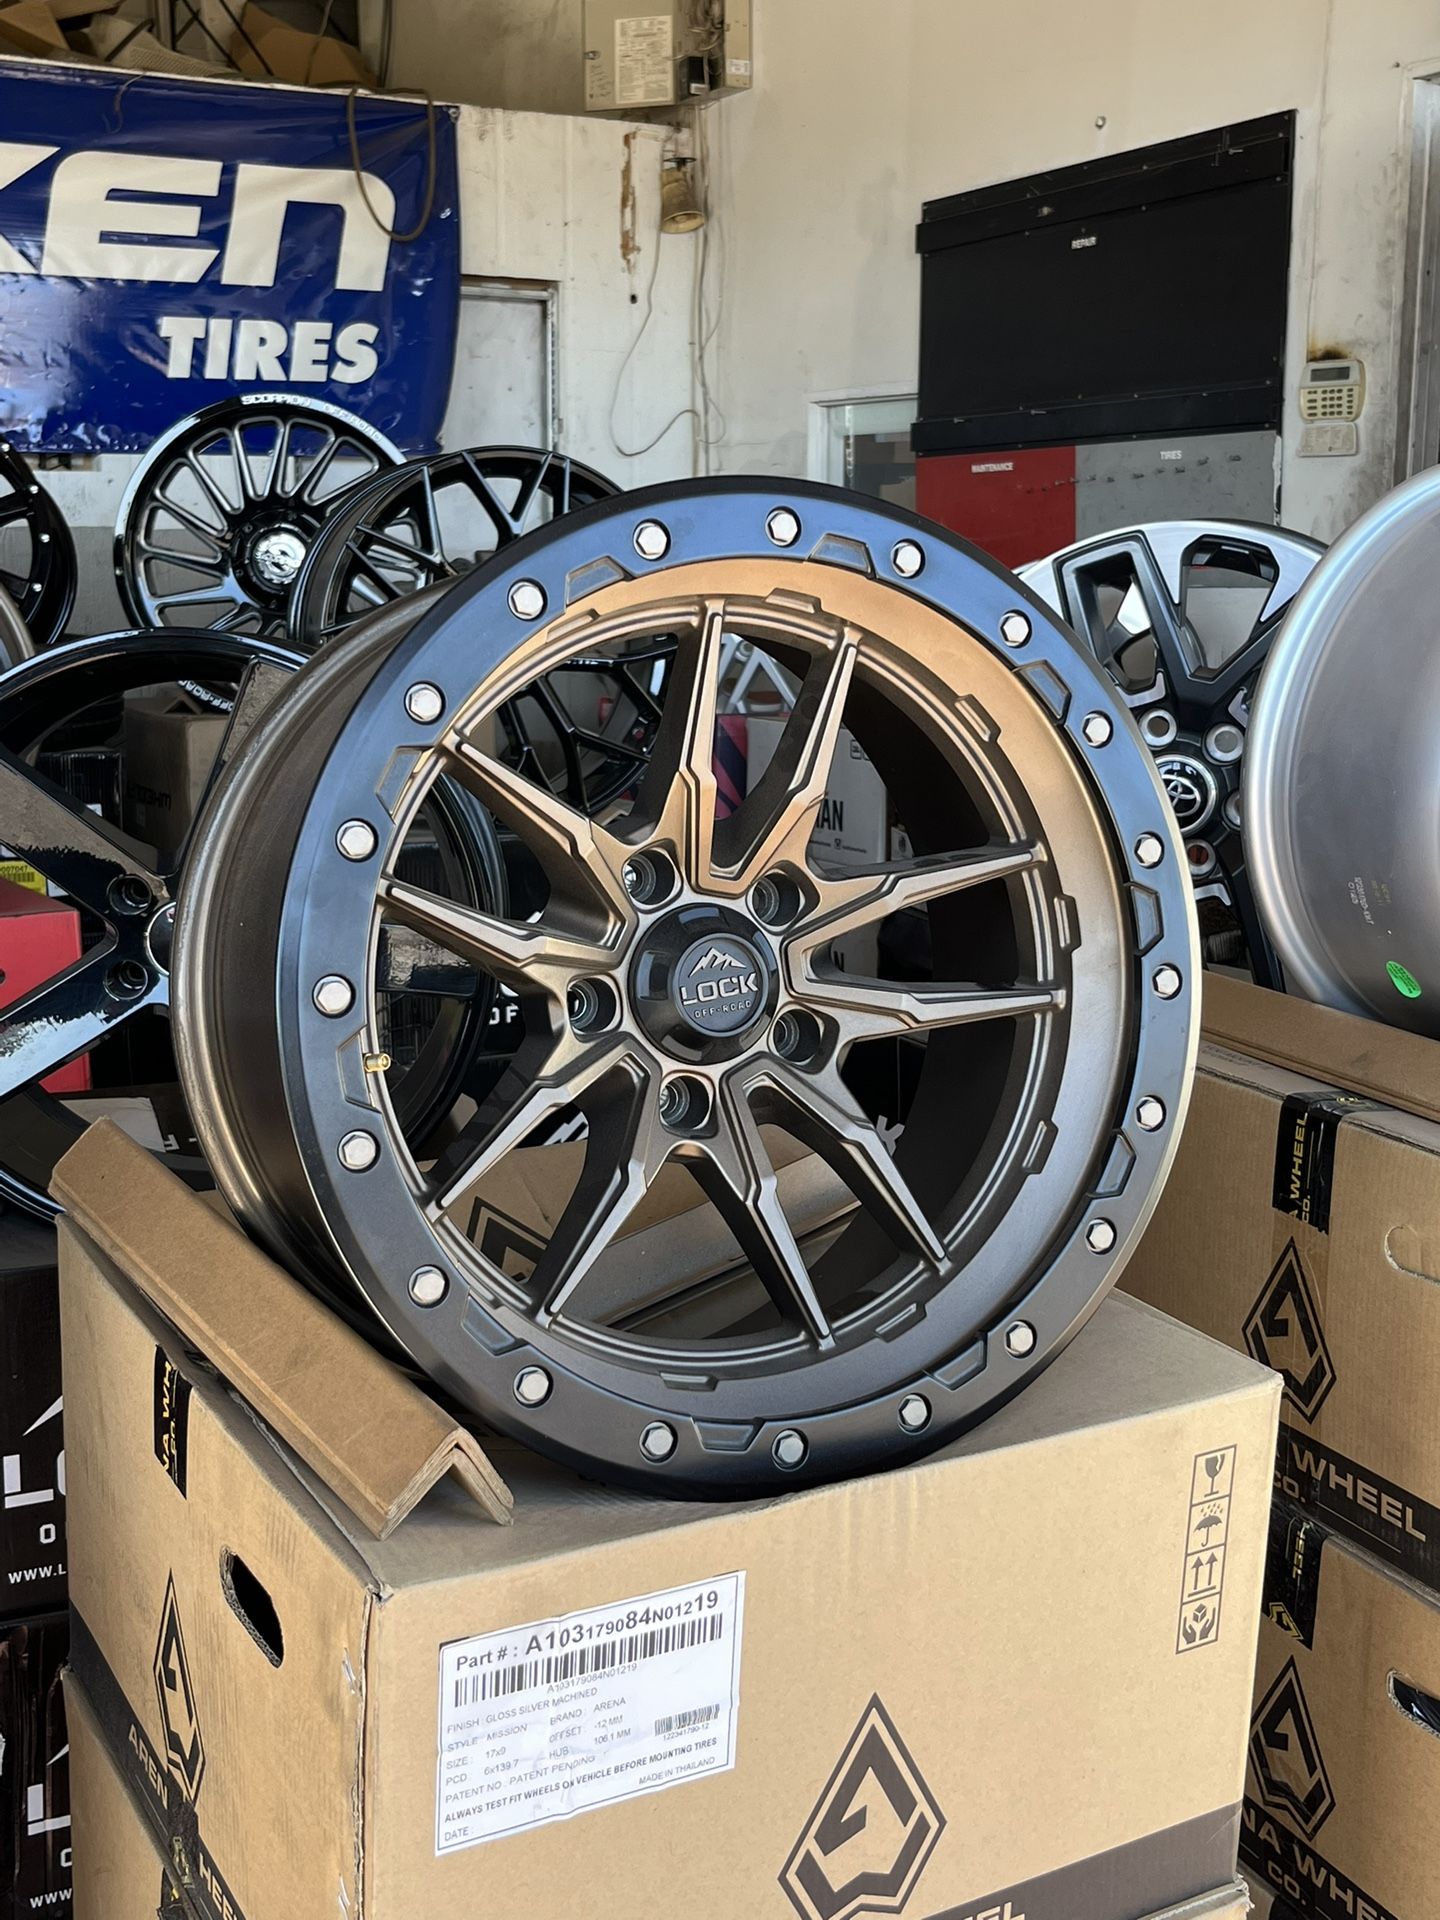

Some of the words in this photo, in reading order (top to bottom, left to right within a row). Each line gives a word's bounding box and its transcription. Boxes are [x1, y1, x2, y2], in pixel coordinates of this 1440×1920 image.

[160, 316, 381, 384] TIRES
[241, 393, 312, 408] SCORPION
[971, 462, 1014, 473] MAINTENANCE
[1160, 450, 1183, 460] TIRES
[679, 972, 759, 1006] LOCK
[694, 1000, 752, 1019] OFF-ROAD
[1289, 1111, 1309, 1199] WHEEL
[1291, 1441, 1427, 1543] WHEEL
[456, 1650, 493, 1671] Part
[525, 1590, 719, 1655] A103179084N01219
[547, 1662, 638, 1694] A103179084N01219
[486, 1708, 518, 1724] GLOSS
[519, 1699, 550, 1715] SILVER
[552, 1687, 598, 1707] MACHINED
[550, 1708, 583, 1726] BRAND
[593, 1697, 626, 1713] ARENA
[447, 1736, 478, 1752] STYLE
[486, 1723, 528, 1741] MISSION
[549, 1725, 582, 1743] OFFSET
[549, 1746, 569, 1760] HUB
[594, 1732, 614, 1745] 1061
[617, 1728, 631, 1740] MM
[444, 1804, 483, 1824] ALWAYS
[485, 1797, 508, 1812] TEST
[509, 1792, 522, 1806] FIT
[524, 1782, 561, 1800] WHEELS
[562, 1778, 575, 1790] ON
[576, 1767, 612, 1785] VEHICLE
[613, 1756, 648, 1775] BEFORE
[649, 1744, 693, 1764] MOUNTING
[694, 1737, 718, 1751] TIRES
[445, 1772, 468, 1786] PCD
[484, 1758, 520, 1776] 6x1397
[445, 1785, 485, 1803] PATENT
[509, 1766, 549, 1786] PATENT
[551, 1755, 596, 1774] PENDING
[639, 1770, 664, 1784] MADE
[665, 1768, 673, 1778] IN
[676, 1756, 716, 1775] THAILAND
[200, 1852, 238, 1920] HEE
[1292, 1843, 1386, 1920] WHE
